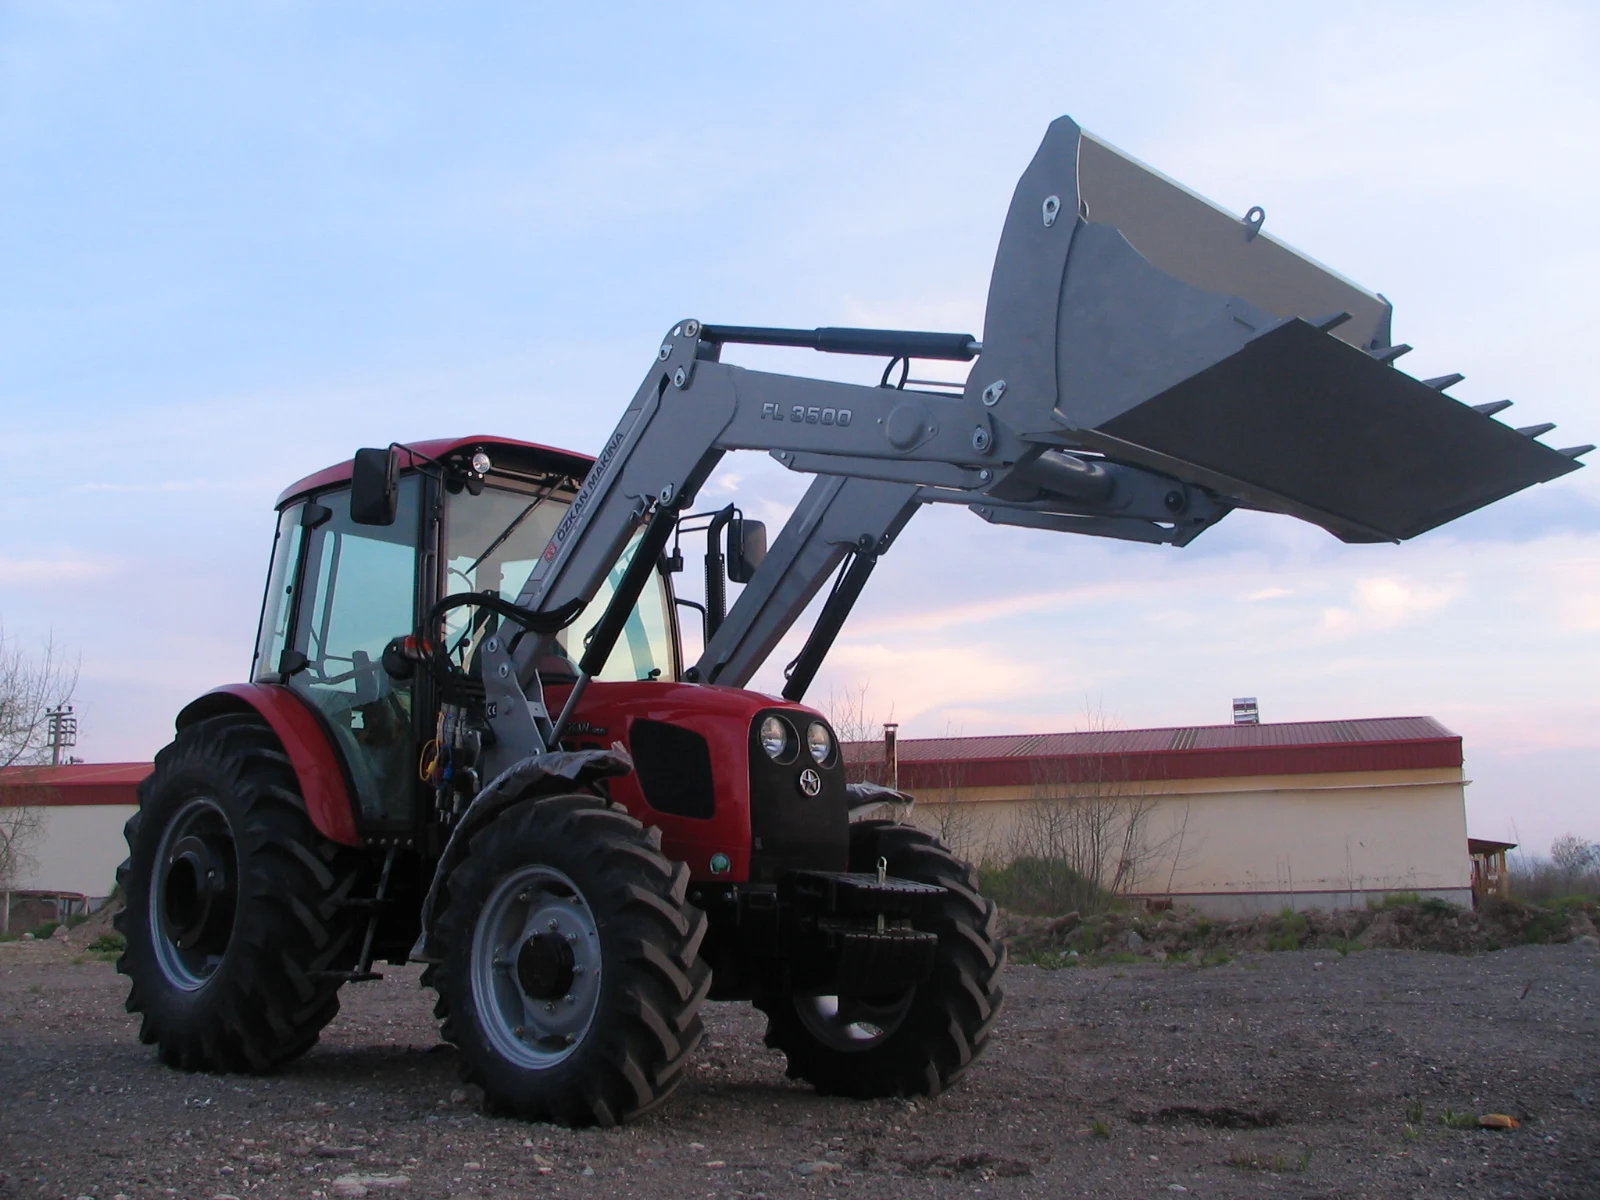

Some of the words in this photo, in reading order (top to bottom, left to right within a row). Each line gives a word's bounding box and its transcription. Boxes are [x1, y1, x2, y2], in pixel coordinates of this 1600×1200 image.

[761, 402, 784, 421] FL
[790, 405, 852, 427] 3500
[557, 490, 588, 541] ÖZKAN
[487, 704, 497, 716] CE
